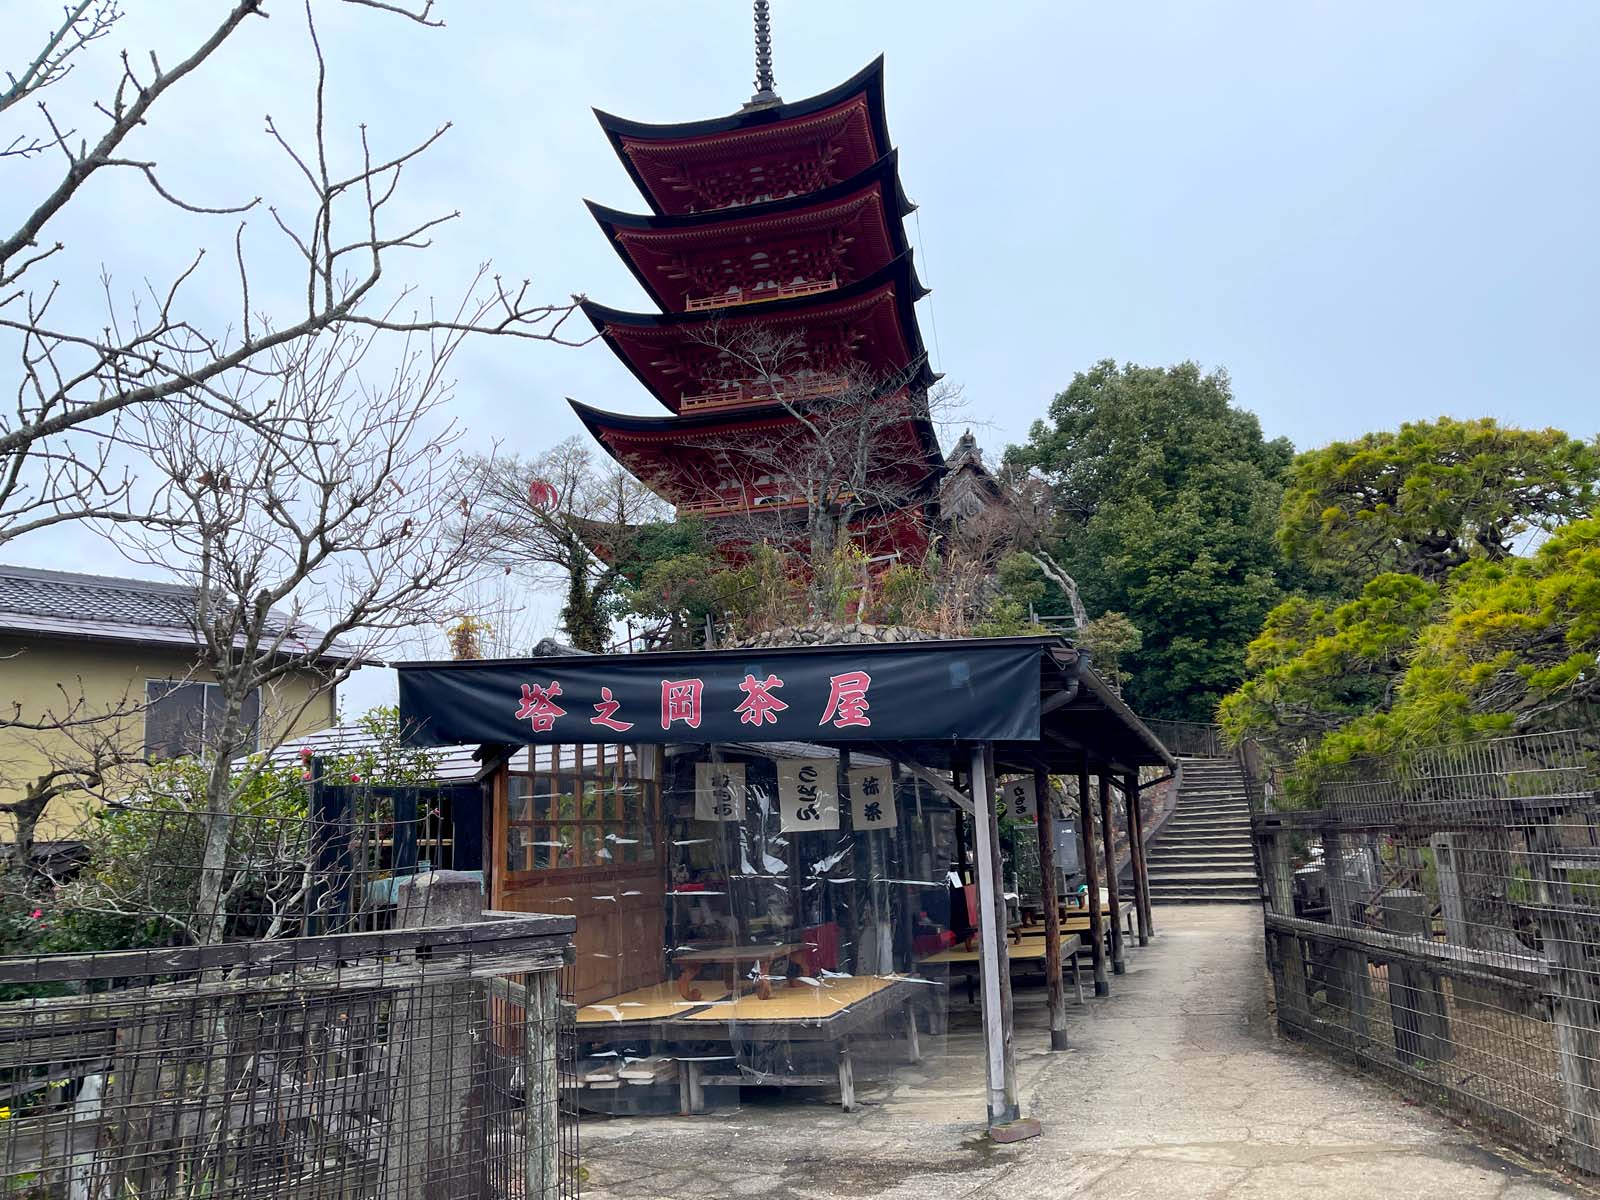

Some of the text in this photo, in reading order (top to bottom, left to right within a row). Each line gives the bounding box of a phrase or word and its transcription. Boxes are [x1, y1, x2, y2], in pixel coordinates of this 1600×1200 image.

[515, 671, 872, 732] 塔之岡茶屋
